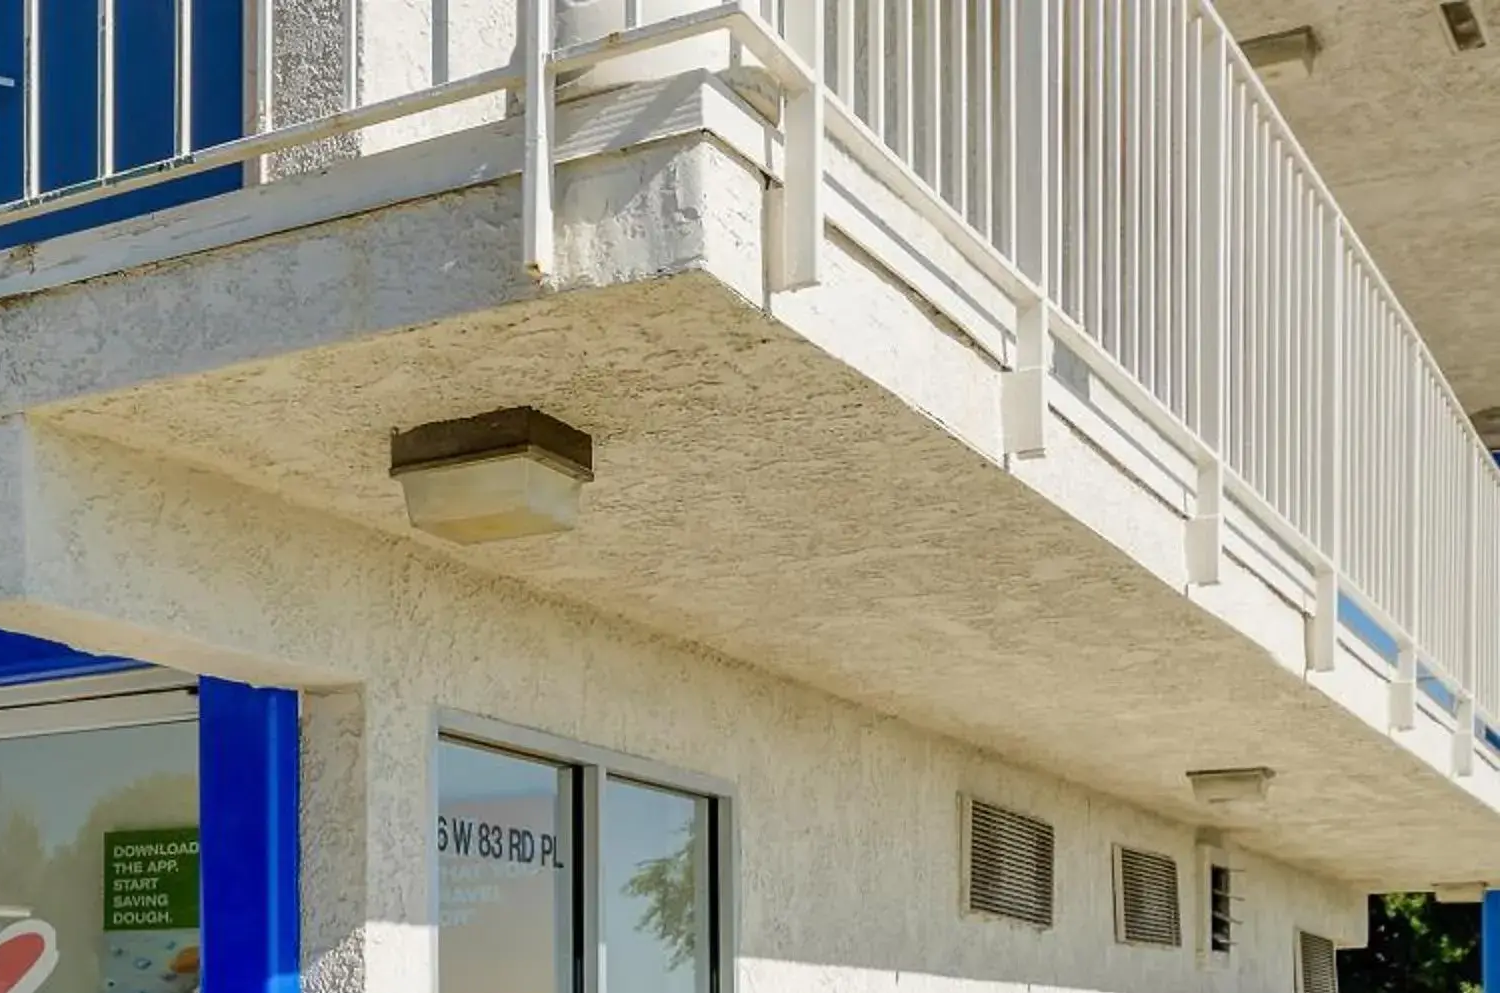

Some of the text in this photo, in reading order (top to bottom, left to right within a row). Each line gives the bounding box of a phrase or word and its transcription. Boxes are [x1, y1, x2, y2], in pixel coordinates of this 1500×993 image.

[113, 842, 199, 858] DOWNLOAD
[452, 818, 473, 856] W
[479, 822, 503, 859] 83
[509, 828, 535, 863] RD
[541, 833, 565, 869] PL
[113, 859, 179, 875] THE APP.
[113, 877, 159, 892] START
[113, 894, 168, 908] SAVING
[113, 911, 174, 925] DOUGH.
